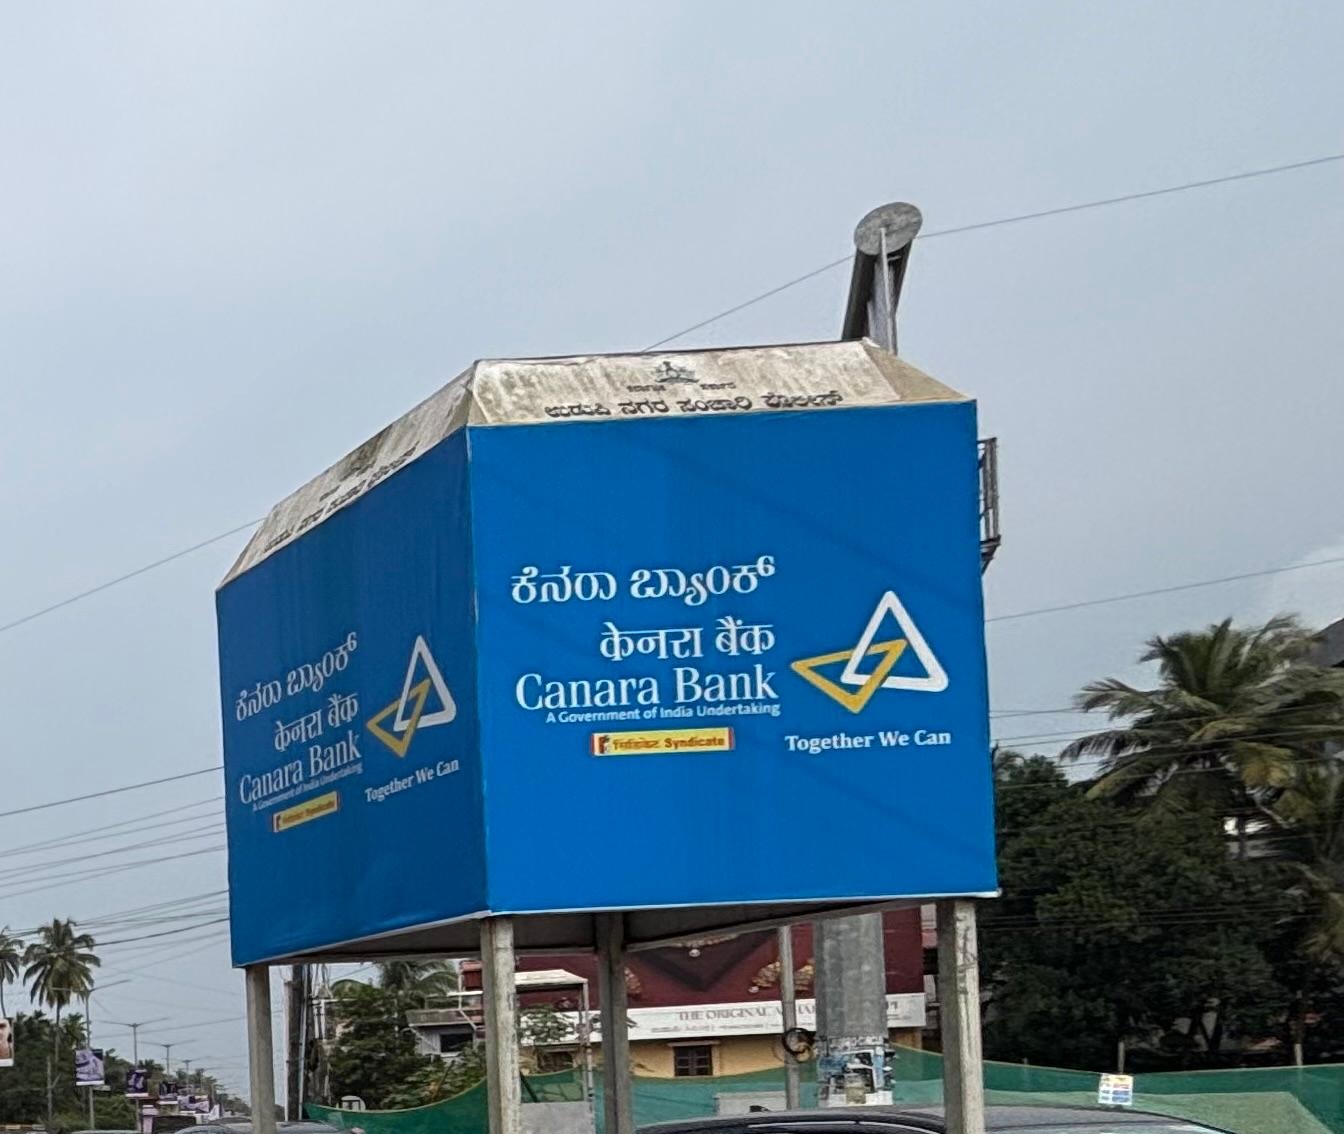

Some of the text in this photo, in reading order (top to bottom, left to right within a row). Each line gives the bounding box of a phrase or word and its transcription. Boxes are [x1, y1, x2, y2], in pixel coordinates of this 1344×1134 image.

[511, 554, 777, 607] ಕೆನರಾ ಬ್ಯಾಂಕ್
[599, 615, 776, 662] केनरा बैंक
[236, 632, 358, 722] ಕೆನರಾ ಬ್ಯಾಂಕ್
[515, 663, 780, 711] Canara Bank
[275, 692, 359, 752] केनरा बैंक
[546, 702, 781, 724] A Government of India Undertaking
[664, 735, 725, 752] Syndicate
[785, 729, 952, 755] Together We Can
[239, 730, 362, 805] Canara Bank
[365, 759, 460, 803] Together We Can
[678, 1010, 705, 1022] THE
[706, 1006, 767, 1020] ORIGINAL
